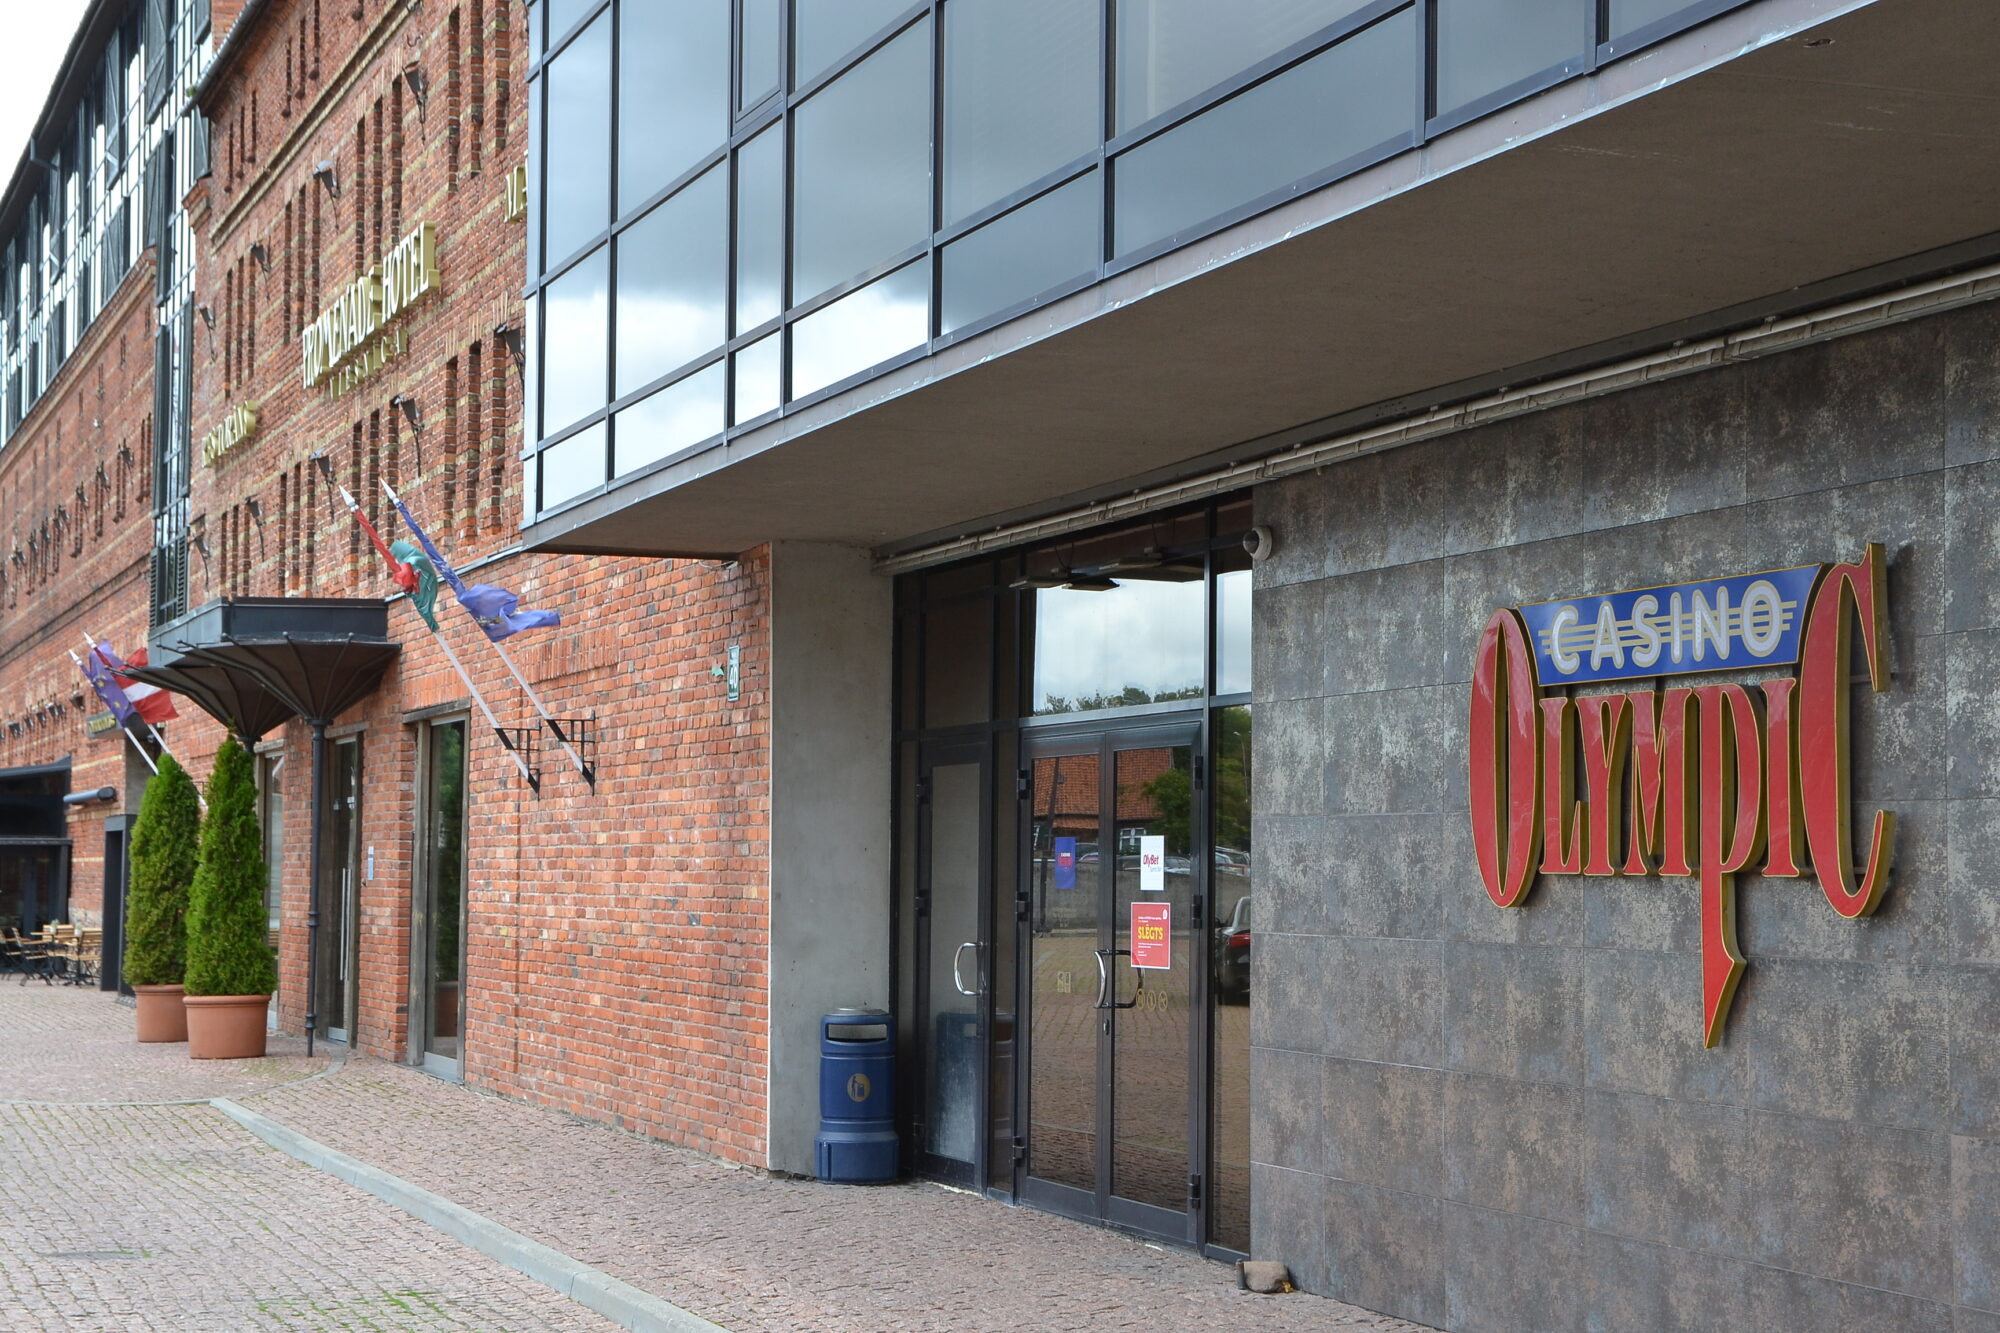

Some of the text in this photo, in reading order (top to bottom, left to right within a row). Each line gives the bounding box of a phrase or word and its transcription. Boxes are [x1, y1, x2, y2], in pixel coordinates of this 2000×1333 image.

[302, 221, 436, 390] PROMENADE HOTEL
[1547, 579, 1783, 675] CASINO
[1469, 543, 1896, 1049] OLYMPIC
[1137, 924, 1164, 941] SLĒGTS
